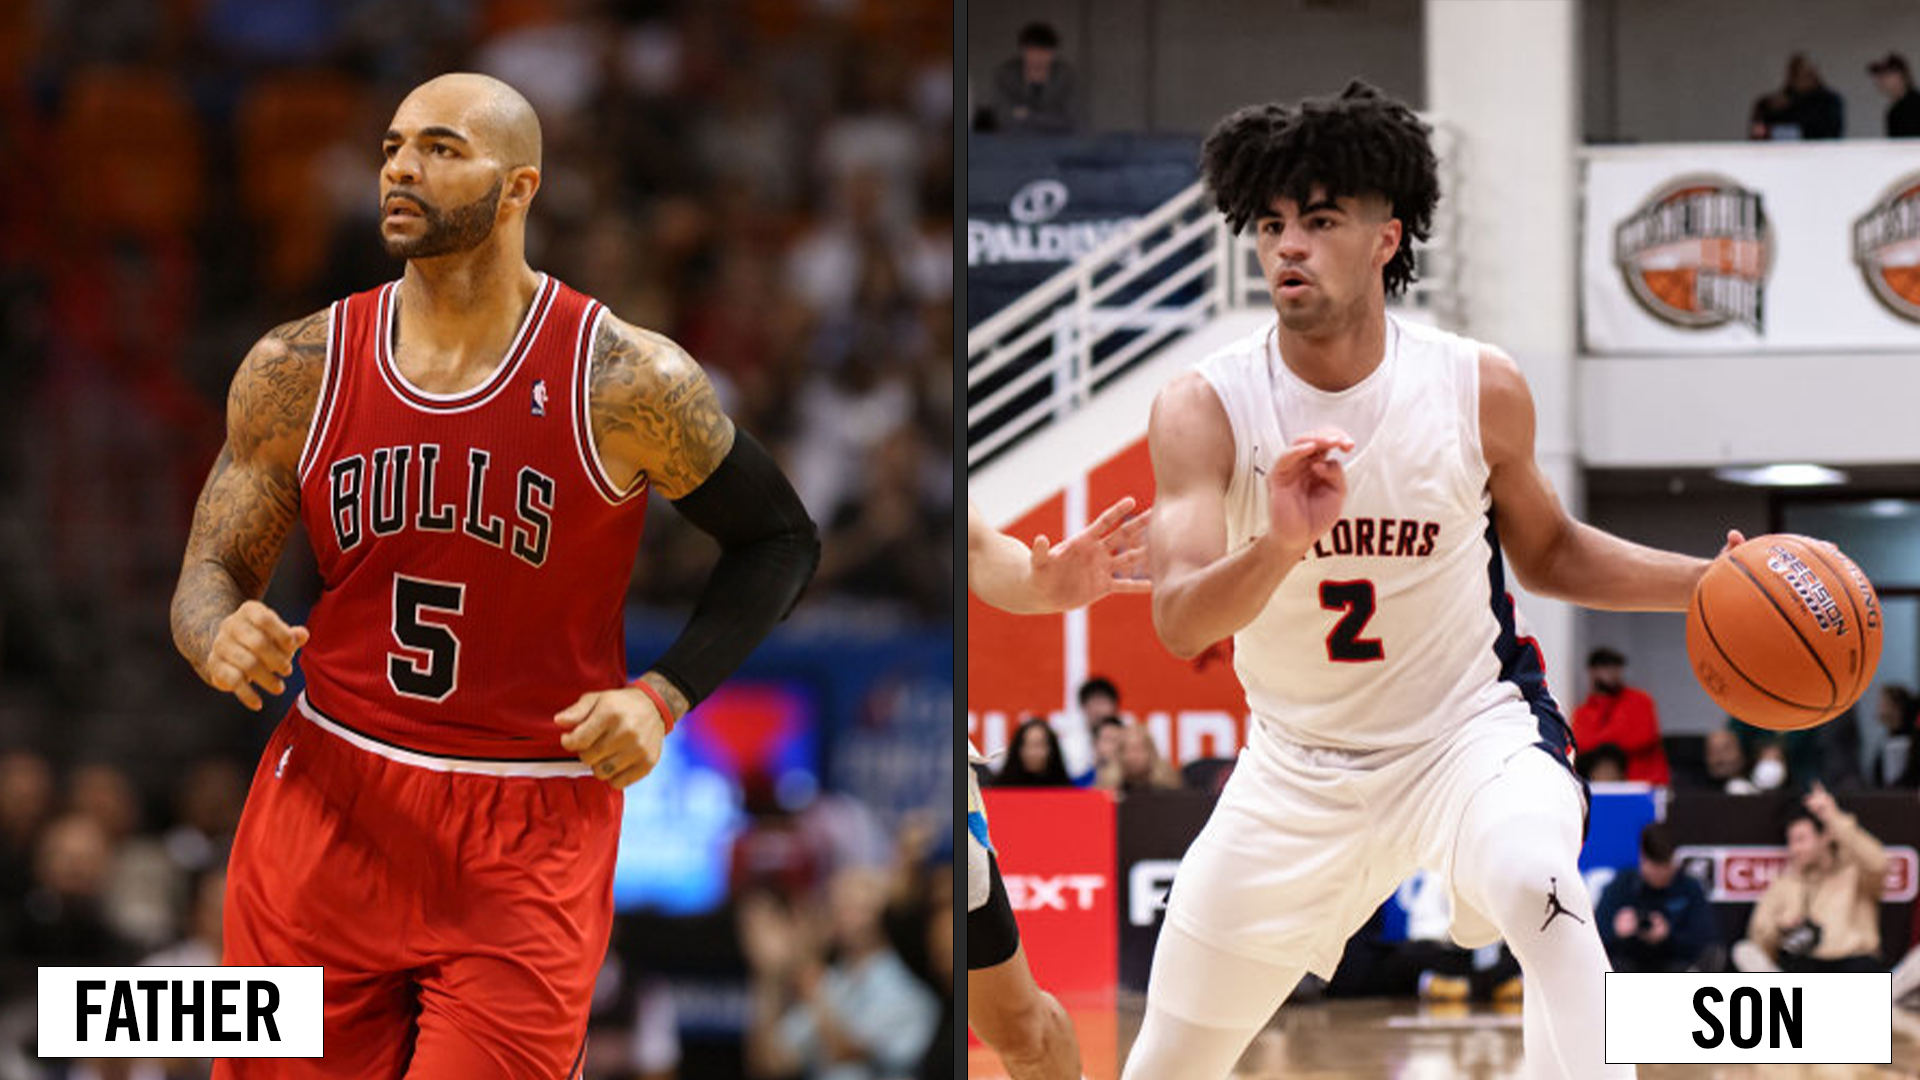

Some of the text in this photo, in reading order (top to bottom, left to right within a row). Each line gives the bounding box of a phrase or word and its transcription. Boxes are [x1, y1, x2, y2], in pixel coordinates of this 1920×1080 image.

[330, 443, 556, 568] BULLS
[1313, 517, 1441, 559] LORERS
[1318, 578, 1385, 663] 2
[1766, 545, 1850, 637] PRECISION
[387, 572, 466, 703] 5
[1001, 874, 1106, 911] EXT
